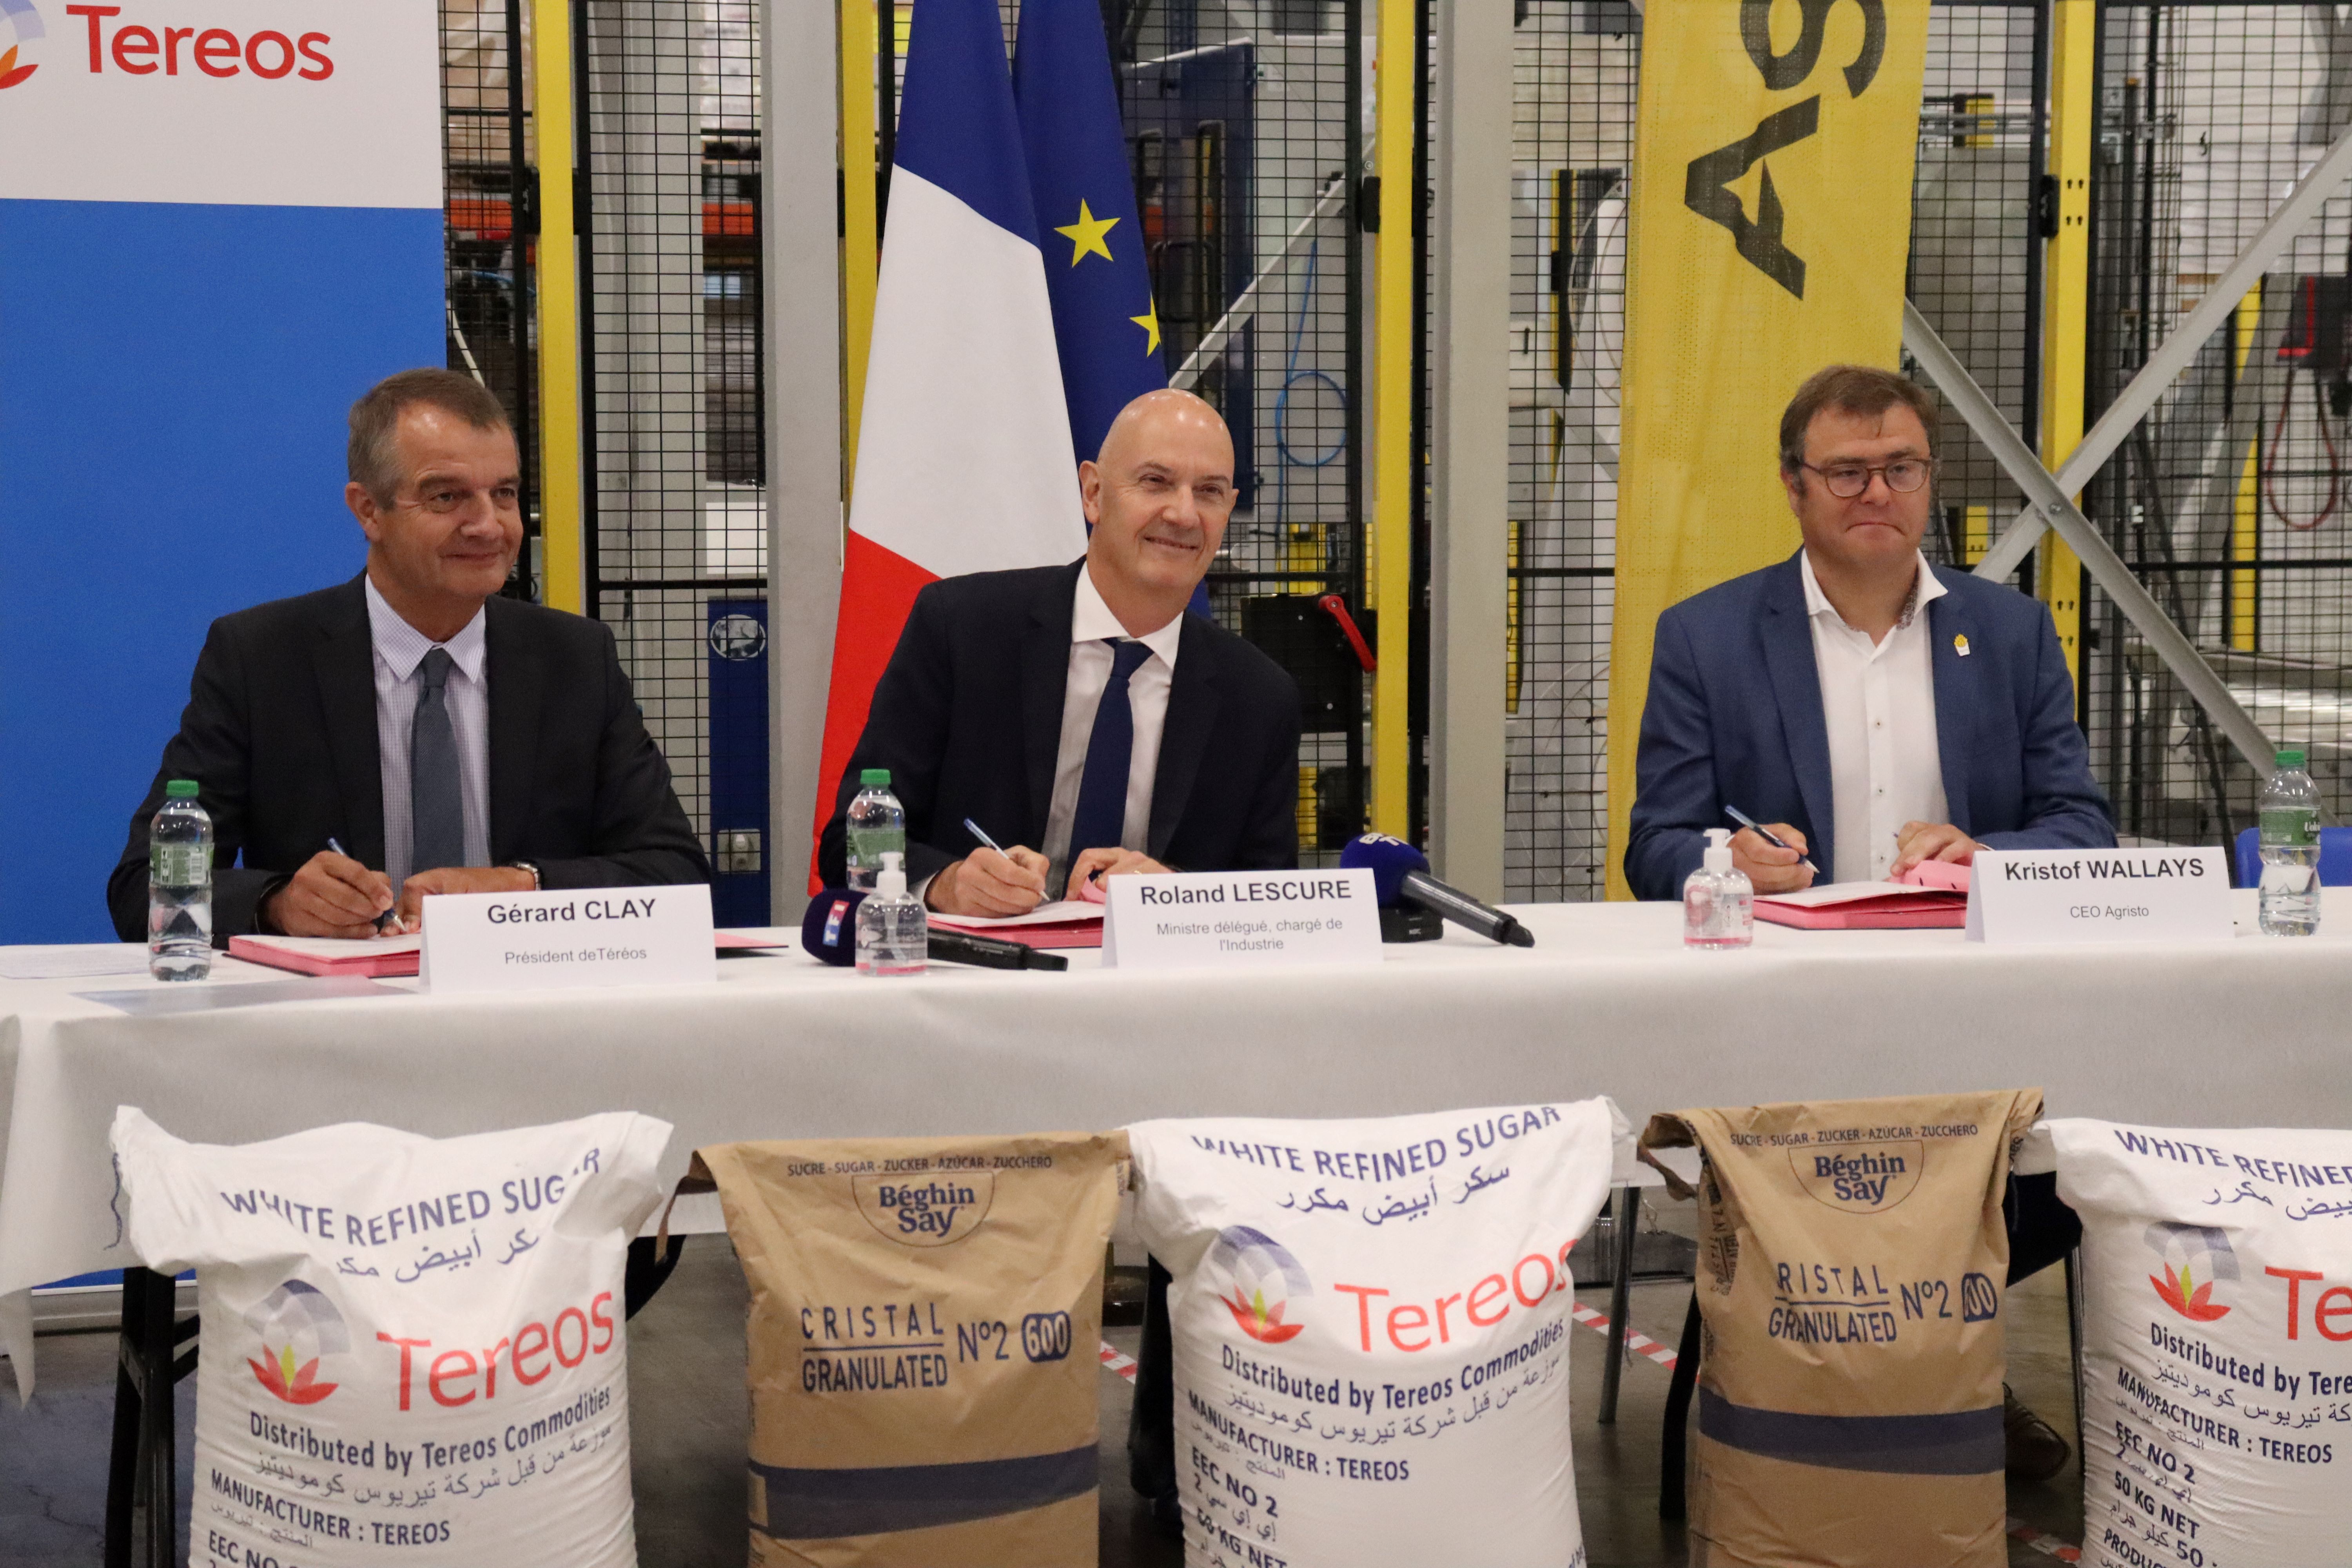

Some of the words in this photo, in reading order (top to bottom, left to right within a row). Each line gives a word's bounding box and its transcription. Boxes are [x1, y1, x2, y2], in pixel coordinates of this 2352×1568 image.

[66, 4, 334, 81] Tereos
[2005, 861, 2080, 880] Kristof
[2087, 858, 2204, 878] WALLAYS
[1141, 884, 1225, 905] Roland
[1234, 880, 1352, 902] LESCURE
[487, 902, 575, 924] Gérard
[585, 898, 656, 920] CLAY
[1157, 923, 1210, 935] Ministre
[1276, 918, 1322, 933] chargé
[1326, 918, 1343, 930] de
[2070, 906, 2100, 918] CEO
[2105, 905, 2149, 920] Agristo
[505, 950, 574, 964] Président
[1220, 938, 1284, 951] l'Industrie
[1313, 1139, 1447, 1183] REFINED
[1457, 1106, 1561, 1157] SUGAR
[1730, 1133, 1762, 1147] SUCRE
[1771, 1133, 1808, 1146] SUGAR
[1818, 1129, 1859, 1142] ZUCKER
[1869, 1125, 1913, 1139] AZÚCAR
[1921, 1124, 1978, 1137] ZUCCHERO
[2113, 1129, 2229, 1167] WHITE
[788, 1163, 826, 1176] SUCRE
[835, 1162, 875, 1173] SUGAR
[884, 1158, 929, 1171] ZUCKER
[994, 1156, 1052, 1169] ZUCCHERO
[1815, 1152, 1906, 1181] Béghin
[347, 1190, 490, 1247] REFINED
[502, 1148, 599, 1214] SUGR
[878, 1182, 975, 1212] Béghin
[1276, 1187, 1348, 1212] مكرر
[1363, 1175, 1437, 1225] أبيض
[1453, 1164, 1510, 1204] سكر
[1833, 1176, 1890, 1205] Say
[2202, 1181, 2274, 1206] مكرر
[898, 1206, 959, 1238] Say
[395, 1227, 481, 1283] أبيض
[1334, 1239, 1579, 1353] Tereos
[1777, 1263, 1889, 1297] RISTAL
[801, 1303, 944, 1339] CRISTAL
[1024, 1312, 1069, 1358] 600
[1768, 1307, 1897, 1343] GRANULATED
[376, 1290, 614, 1411] Tereos
[1222, 1345, 1339, 1405] Distributed
[1350, 1381, 1374, 1415] by
[1383, 1377, 1452, 1408] Tereos
[1461, 1318, 1563, 1390] Commodities
[2151, 1323, 2265, 1388] Distributed
[2275, 1366, 2300, 1400] by
[2308, 1372, 2352, 1395] Tere
[803, 1354, 948, 1392] GRANULATED
[1463, 1391, 1490, 1423] قبل
[1497, 1386, 1518, 1409] من
[250, 1412, 374, 1468] Distributed
[385, 1442, 412, 1477] by
[422, 1437, 497, 1469] Tereos
[505, 1385, 610, 1452] Commodities
[1403, 1408, 1456, 1439] شركة
[2118, 1367, 2239, 1449] MANUFACTURER
[2259, 1437, 2332, 1464] TEREOS
[2244, 1406, 2320, 1429] تيريوس
[1189, 1390, 1318, 1474] MANUFACTURER
[1337, 1457, 1410, 1481] TEREOS
[1321, 1421, 1396, 1445] تيريوس
[543, 1450, 564, 1474] من
[2116, 1420, 2142, 1454] EEC
[2147, 1443, 2176, 1472] NO
[2184, 1463, 2195, 1485] 2
[444, 1468, 501, 1499] شركة
[508, 1454, 536, 1486] قبل
[1192, 1445, 1220, 1485] EEC
[1226, 1473, 1257, 1507] NO
[1266, 1495, 1278, 1518] 2
[1194, 1473, 1202, 1493] 2
[212, 1468, 350, 1539] MANUFACTURER
[372, 1520, 450, 1545] TEREOS
[354, 1481, 436, 1508] تيريوس
[2115, 1470, 2131, 1496] 50
[2136, 1485, 2155, 1515] KG
[2161, 1504, 2200, 1539] NET
[209, 1530, 238, 1563] EEC
[2177, 1540, 2203, 1568] 50
